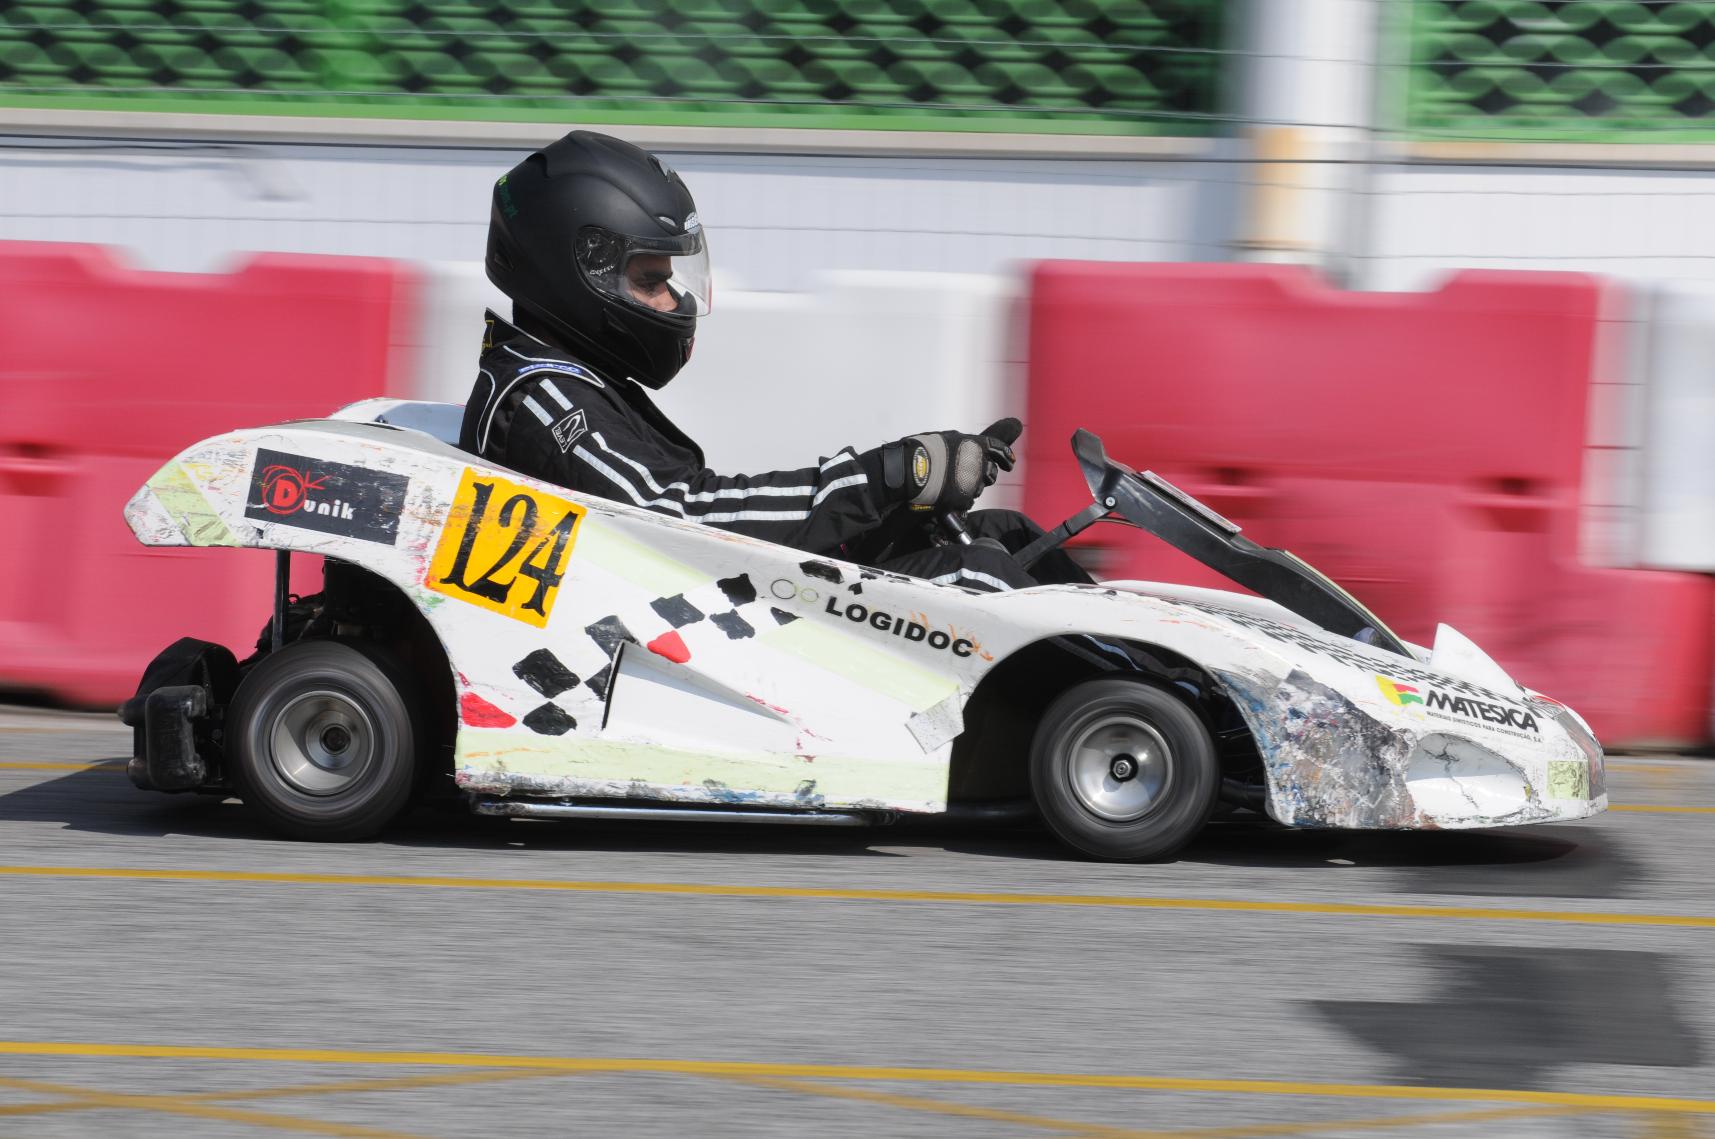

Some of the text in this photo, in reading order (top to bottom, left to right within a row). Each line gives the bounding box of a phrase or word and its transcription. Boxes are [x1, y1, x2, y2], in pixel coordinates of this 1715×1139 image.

[554, 426, 568, 448] LEVEL
[439, 482, 579, 618] 124
[825, 596, 974, 658] LOGIDOC
[1426, 690, 1540, 733] MATESICA
